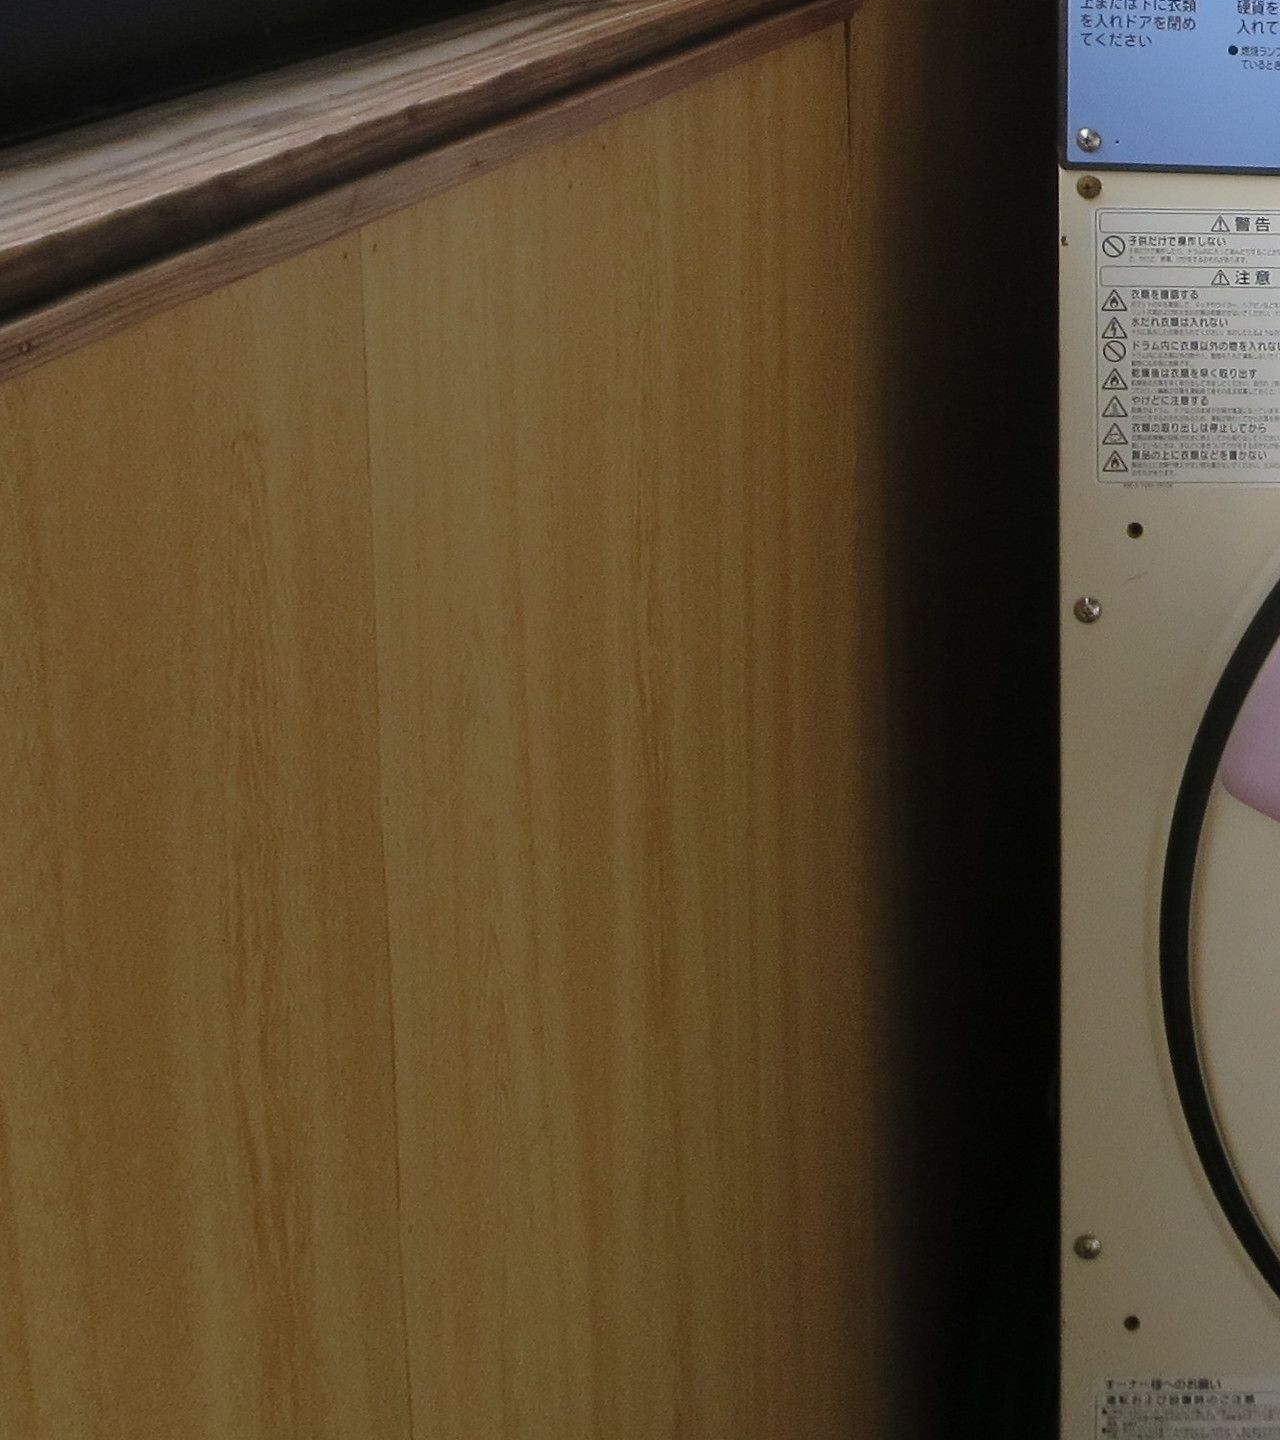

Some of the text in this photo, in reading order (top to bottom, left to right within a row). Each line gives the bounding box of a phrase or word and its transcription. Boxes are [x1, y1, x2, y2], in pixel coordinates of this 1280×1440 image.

[1080, 13, 1196, 31] を入れドアを閉め
[1080, 33, 1152, 48] てください
[1235, 217, 1271, 233] 警告
[1235, 270, 1271, 286] 注意
